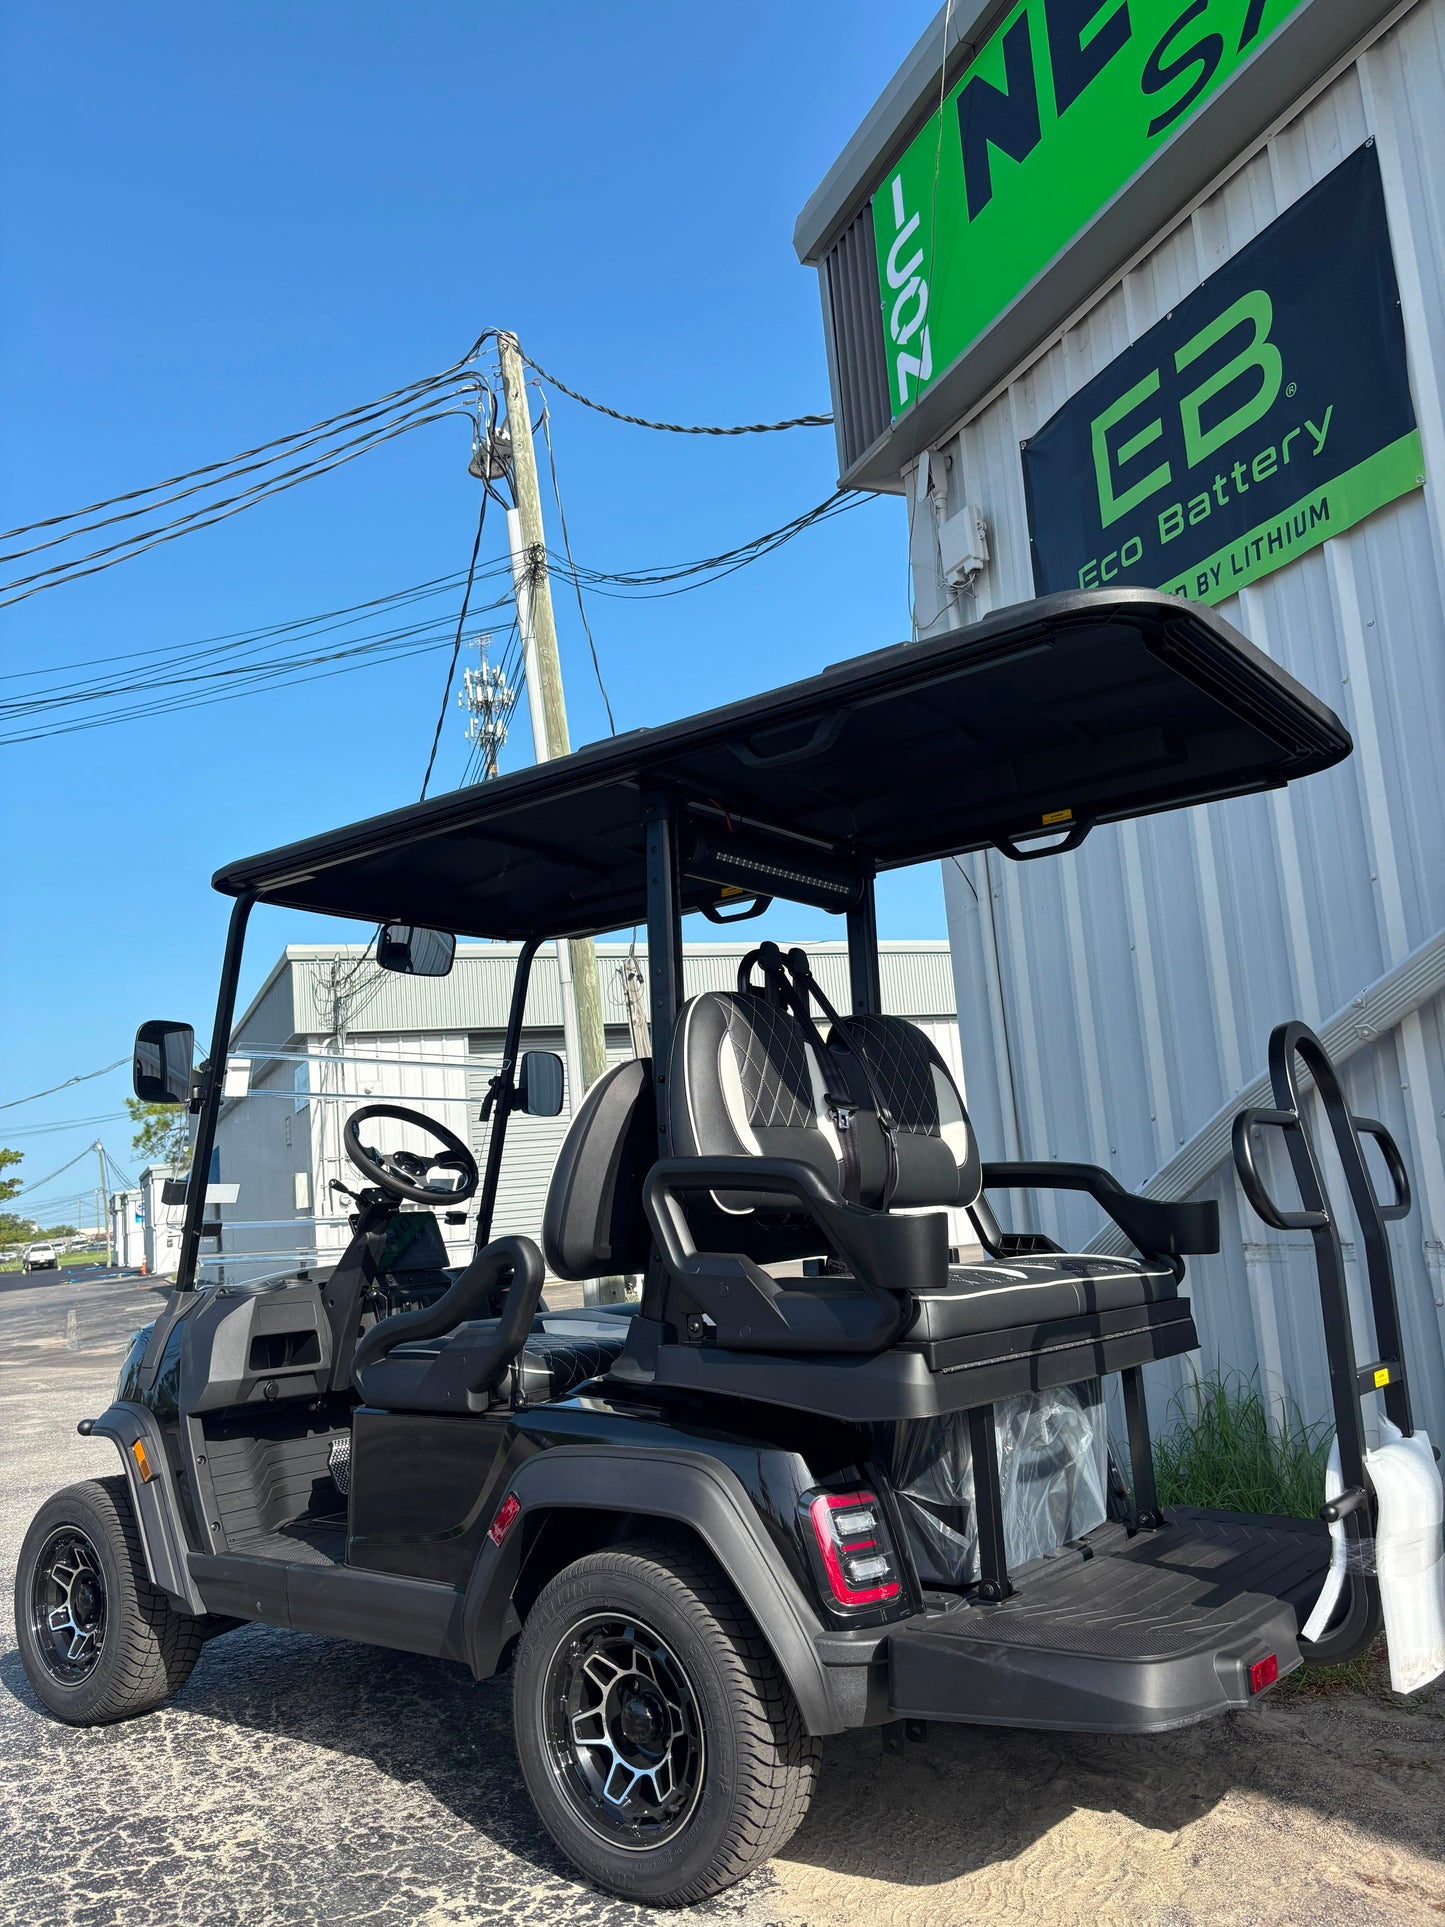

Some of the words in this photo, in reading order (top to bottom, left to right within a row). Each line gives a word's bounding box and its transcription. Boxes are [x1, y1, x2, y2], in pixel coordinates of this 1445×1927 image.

[1078, 535, 1143, 590] Eco
[1157, 404, 1334, 546] Battery
[1196, 562, 1222, 598] BY
[1230, 496, 1331, 577] LITHIUM
